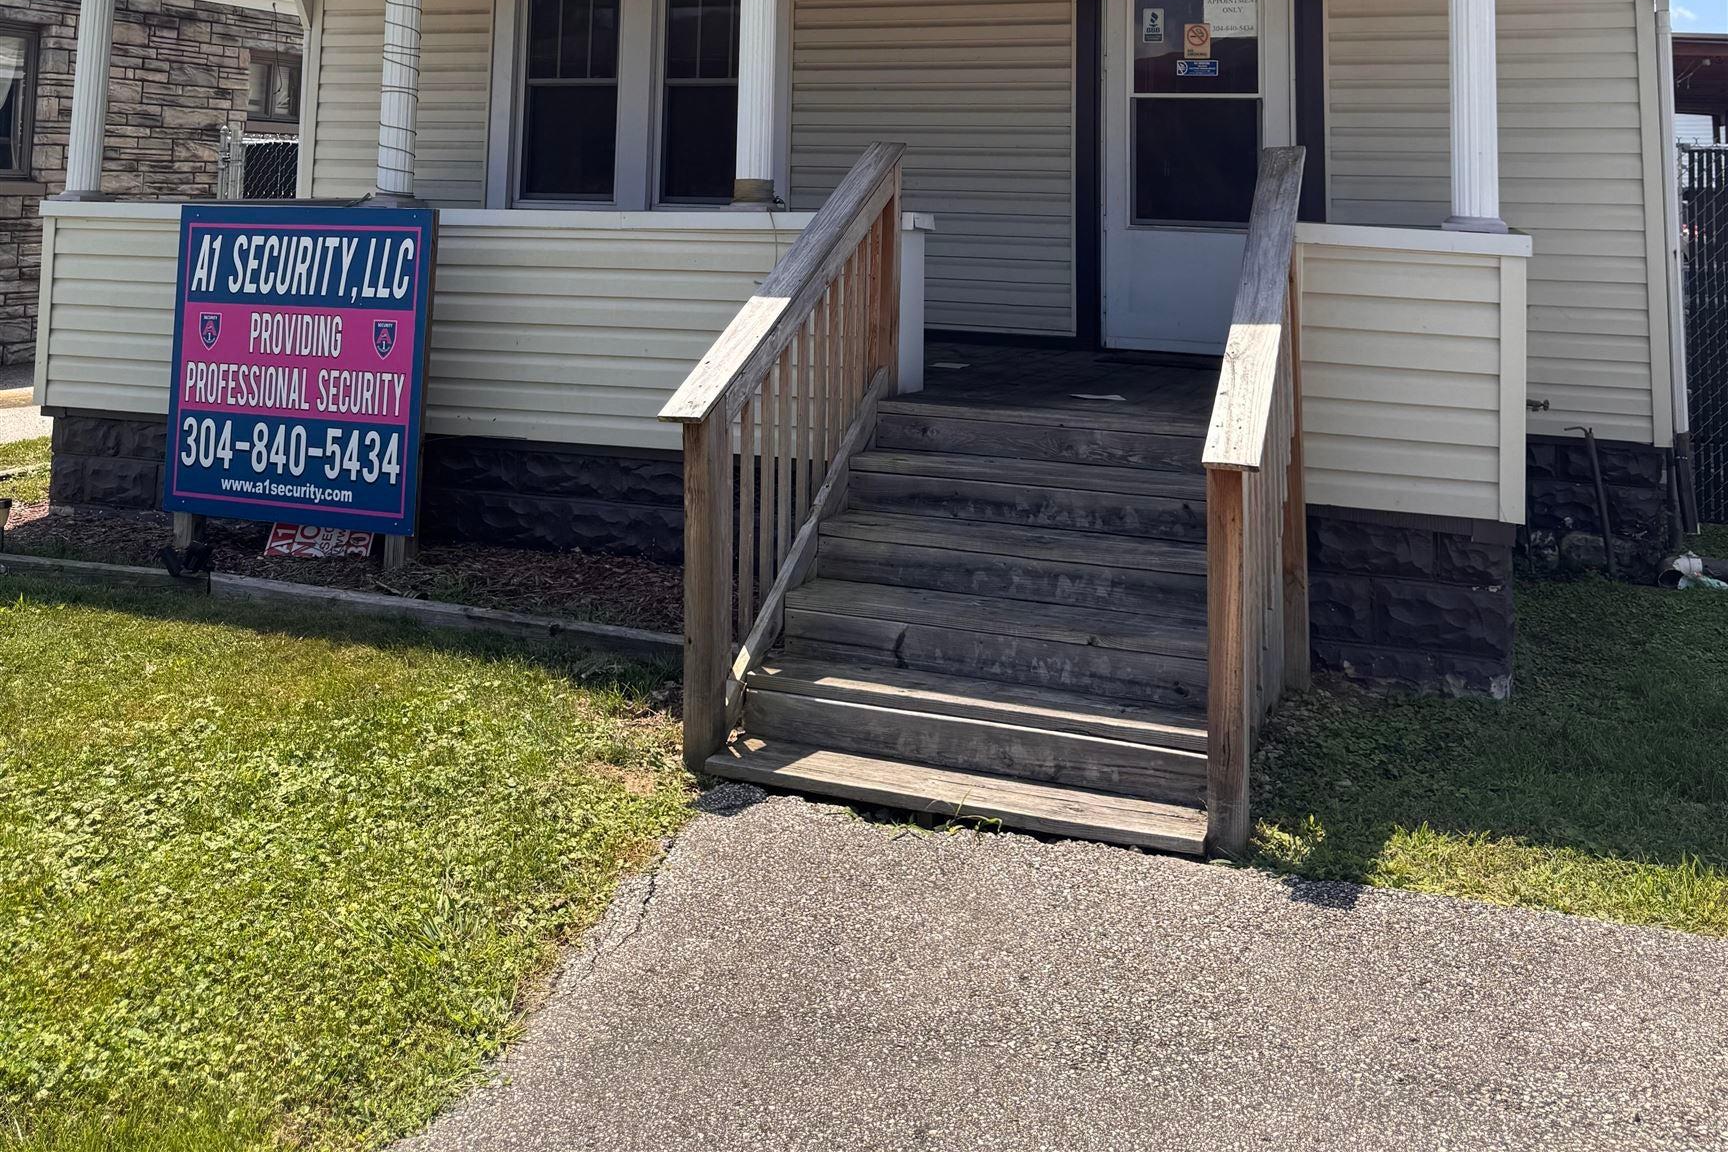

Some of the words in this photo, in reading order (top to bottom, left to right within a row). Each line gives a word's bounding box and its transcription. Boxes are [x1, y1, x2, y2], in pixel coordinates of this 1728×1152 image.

[191, 234, 223, 292] A1
[249, 312, 343, 358] PROVIDING
[184, 361, 310, 410] PROFESSIONAL
[316, 370, 405, 417] SECURITY
[180, 416, 400, 485] 304-840-5434
[221, 477, 353, 504] www.a1security.com
